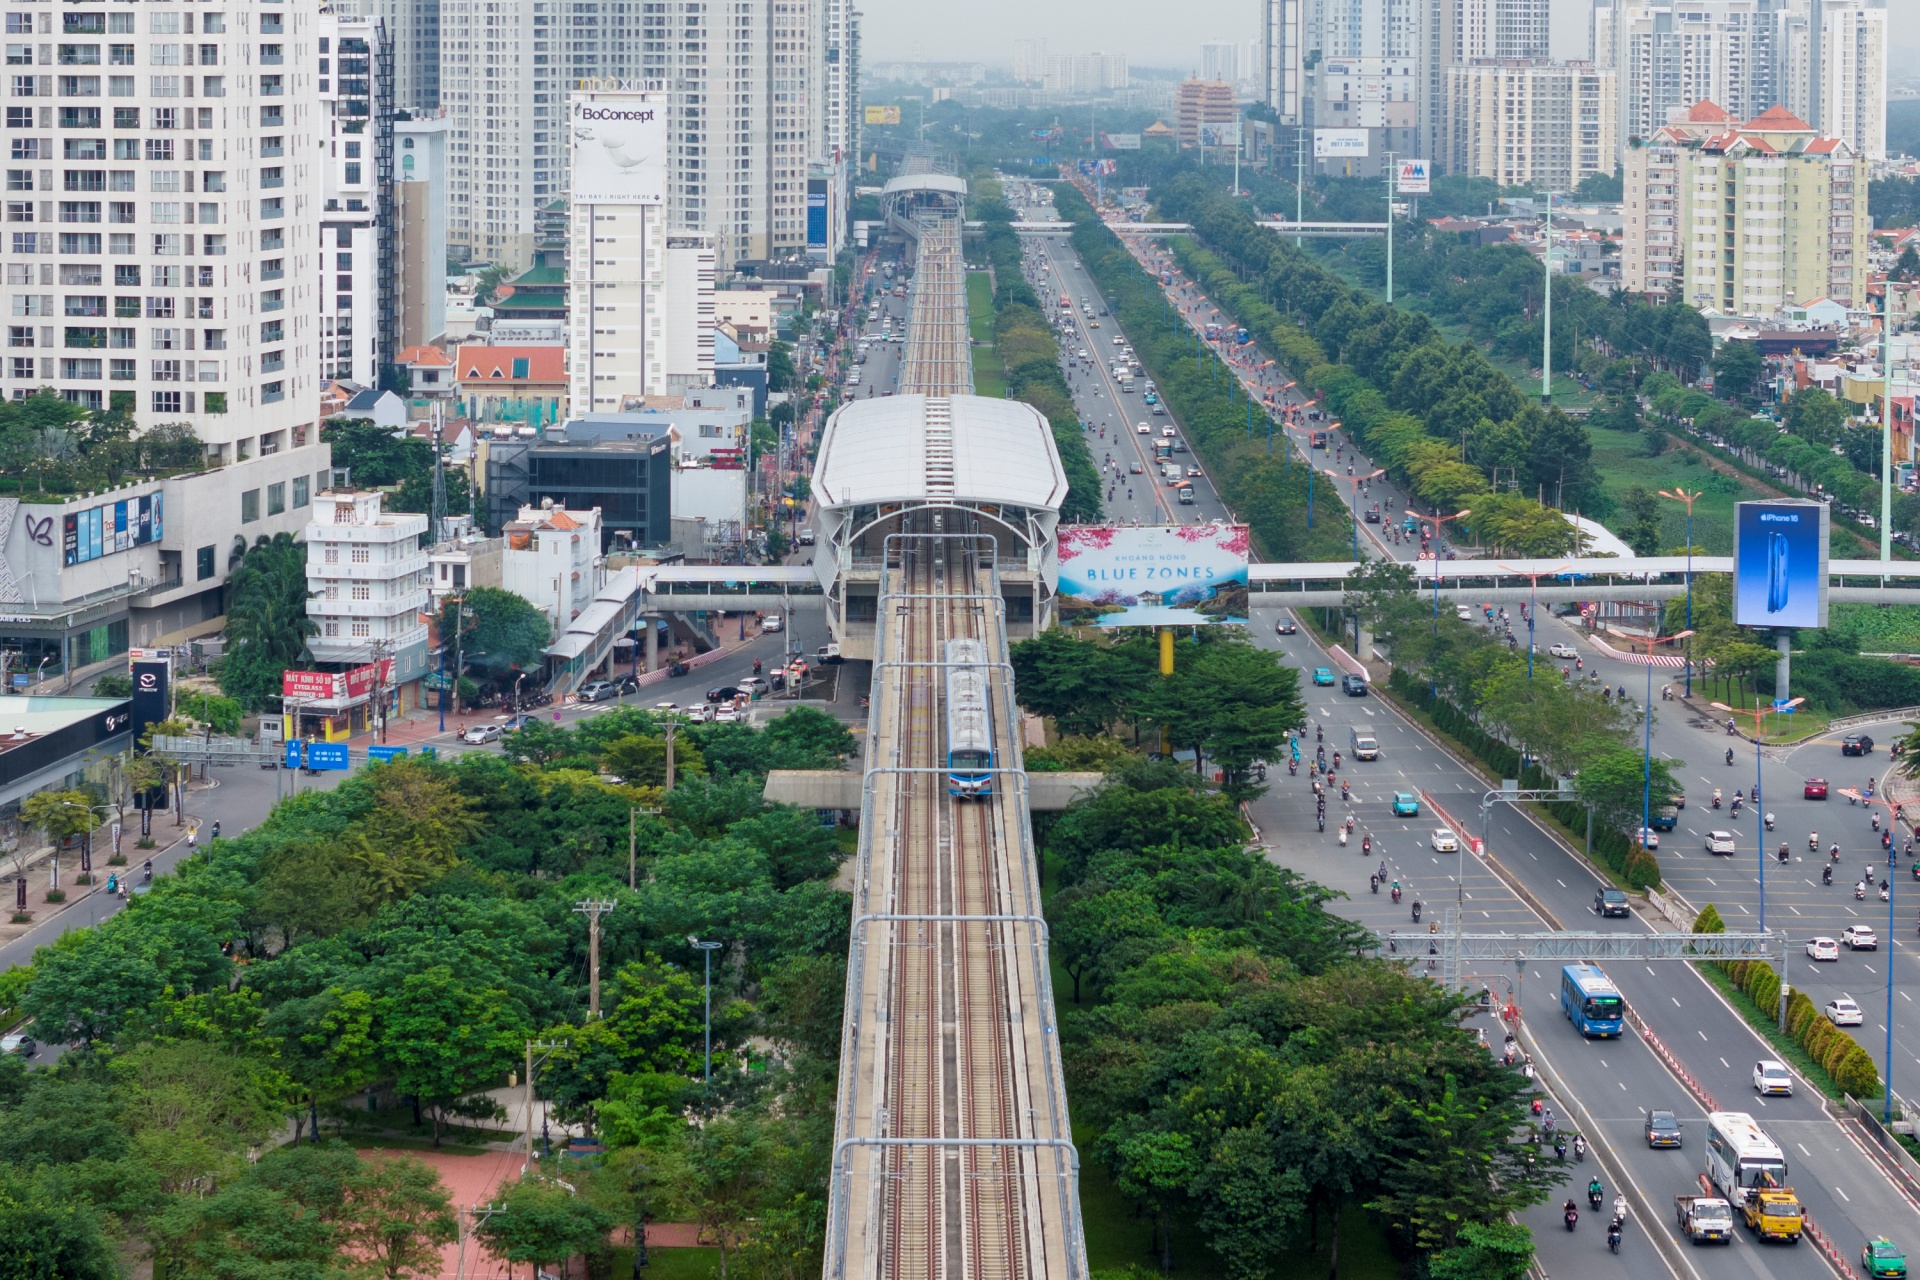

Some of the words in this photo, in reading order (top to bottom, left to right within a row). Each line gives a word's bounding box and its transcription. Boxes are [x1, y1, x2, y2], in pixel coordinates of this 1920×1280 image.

[580, 75, 616, 91] nhà
[619, 76, 657, 91] xinh
[582, 107, 654, 124] BoConcept
[1087, 568, 1138, 581] BLUE
[1146, 566, 1214, 580] ZONES
